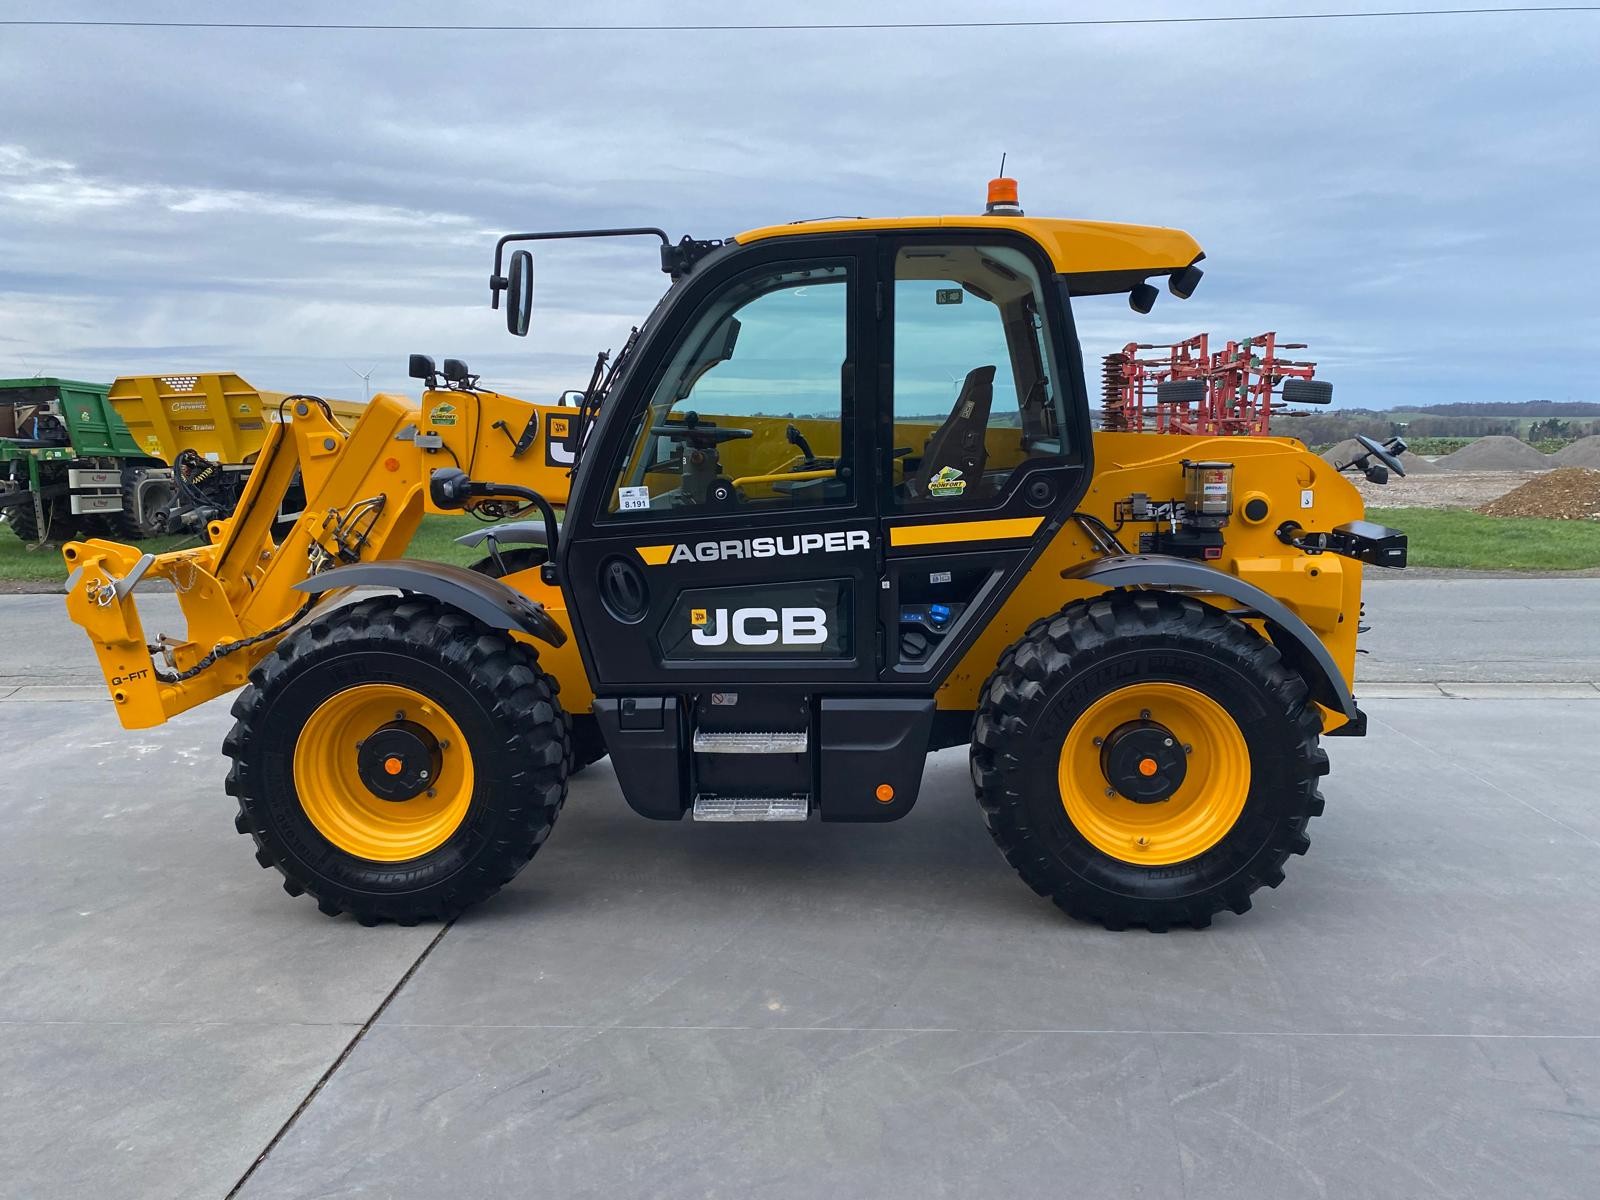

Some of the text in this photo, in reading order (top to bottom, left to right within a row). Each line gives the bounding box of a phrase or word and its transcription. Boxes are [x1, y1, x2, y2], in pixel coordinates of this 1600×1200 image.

[931, 481, 962, 489] MONFORT
[624, 500, 647, 509] 8.191
[691, 607, 828, 646] JCB
[111, 669, 149, 686] Q-FIT
